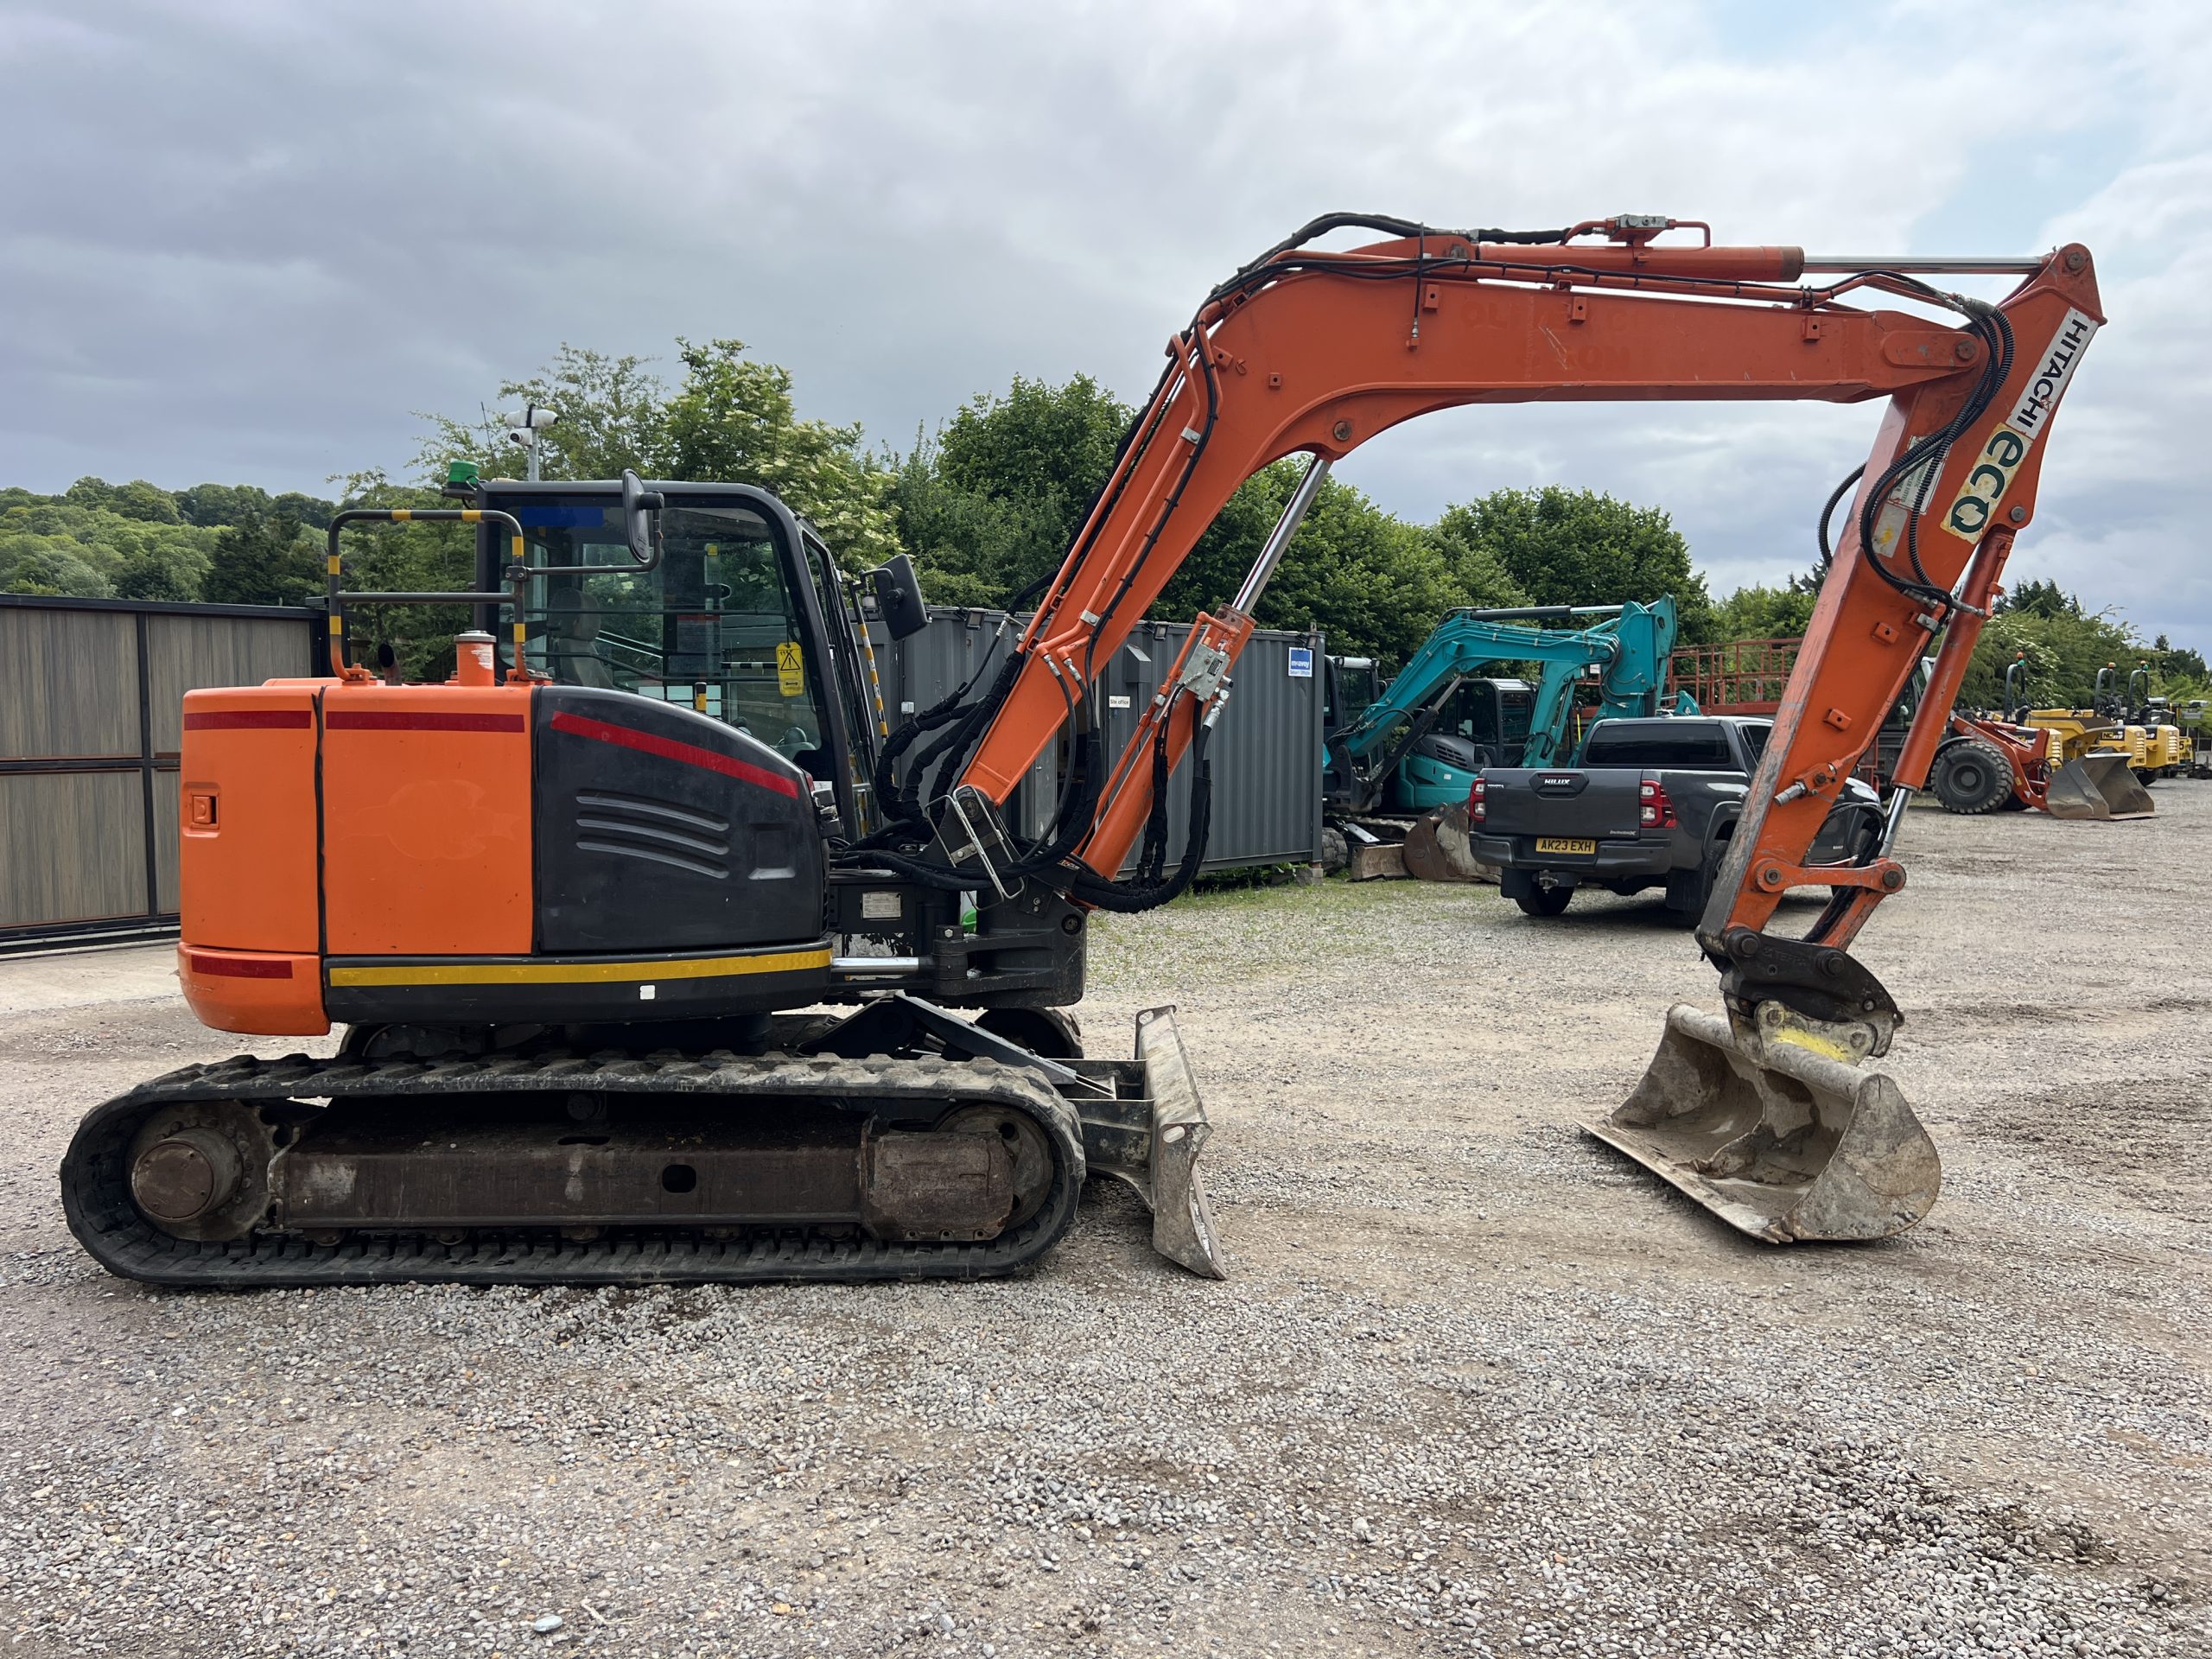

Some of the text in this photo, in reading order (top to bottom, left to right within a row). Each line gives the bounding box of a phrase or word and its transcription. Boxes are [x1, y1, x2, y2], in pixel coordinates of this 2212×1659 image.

[2017, 318, 2088, 429] HITACHI
[1949, 430, 2024, 534] eco
[1541, 839, 1592, 852] AK23 EXH
